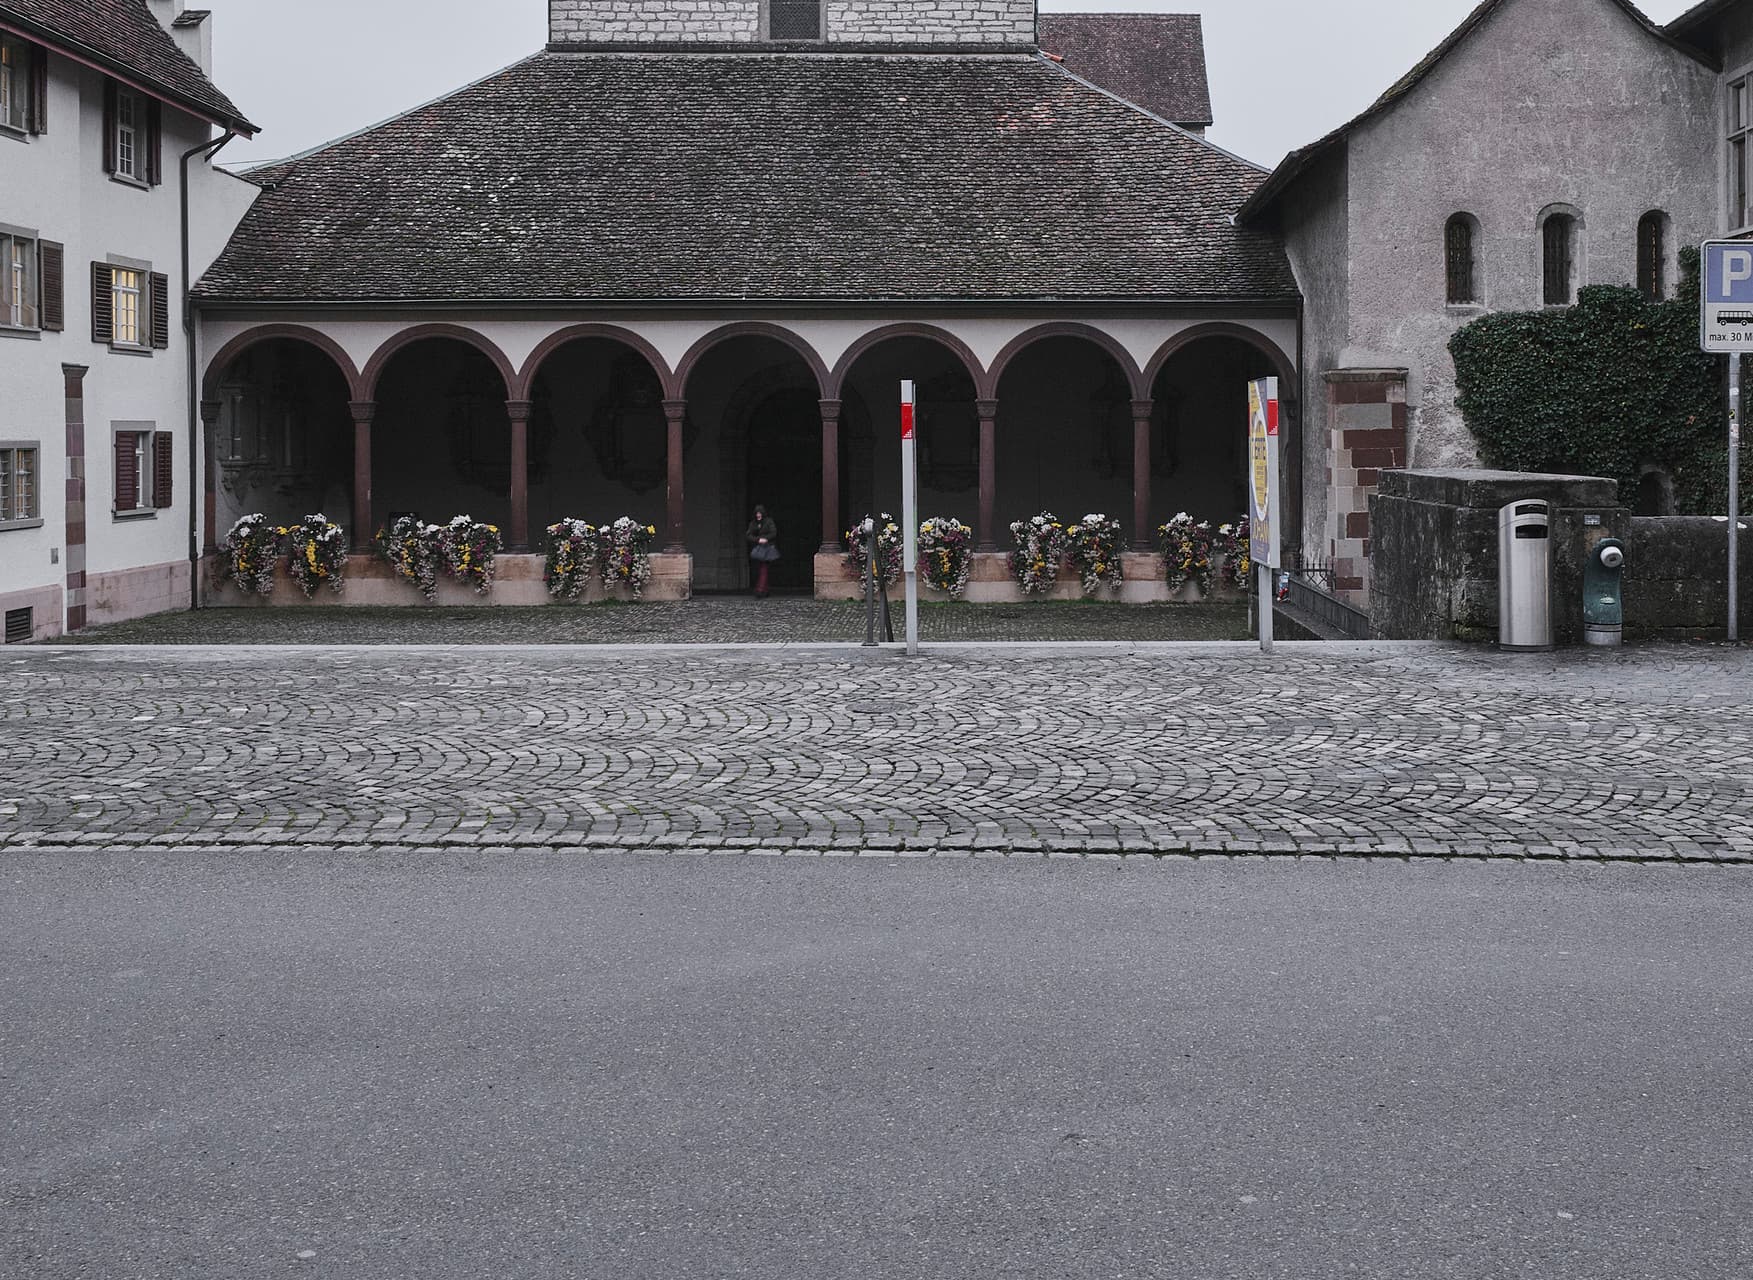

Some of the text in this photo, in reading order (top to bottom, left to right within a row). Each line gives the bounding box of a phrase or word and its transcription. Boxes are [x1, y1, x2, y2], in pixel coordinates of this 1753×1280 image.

[1722, 250, 1752, 297] P
[1709, 333, 1729, 342] max.
[1730, 332, 1742, 342] 30
